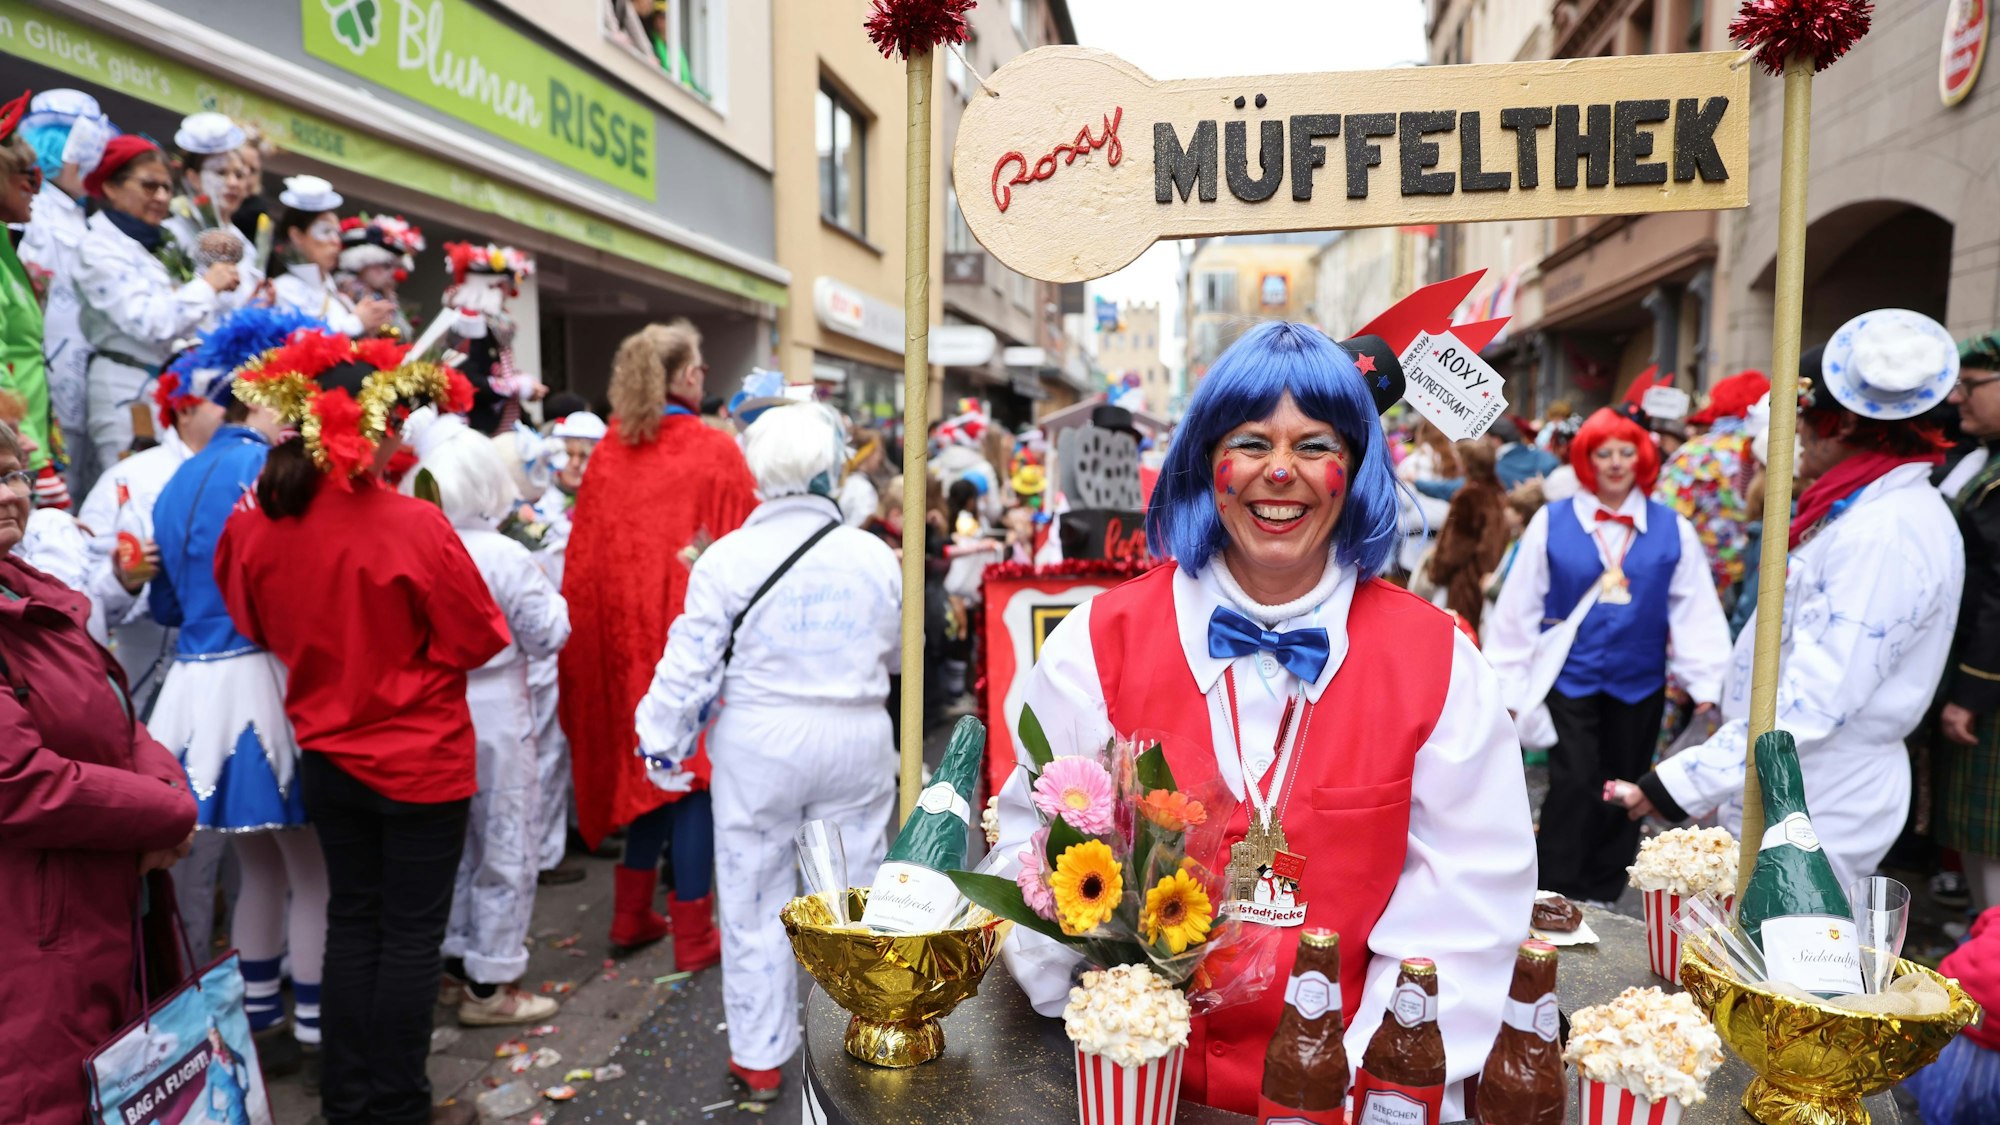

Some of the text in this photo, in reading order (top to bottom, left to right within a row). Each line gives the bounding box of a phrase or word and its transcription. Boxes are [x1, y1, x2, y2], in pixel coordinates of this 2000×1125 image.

[24, 19, 99, 70] Glück
[395, 0, 648, 178] Blumen RISSE
[992, 93, 1730, 213] Roxy MÜFFELTHEK
[1438, 347, 1490, 390] ROXY
[125, 1050, 210, 1125] BAG A FLIGHT!
[1373, 1102, 1418, 1120] BIERCHEN
